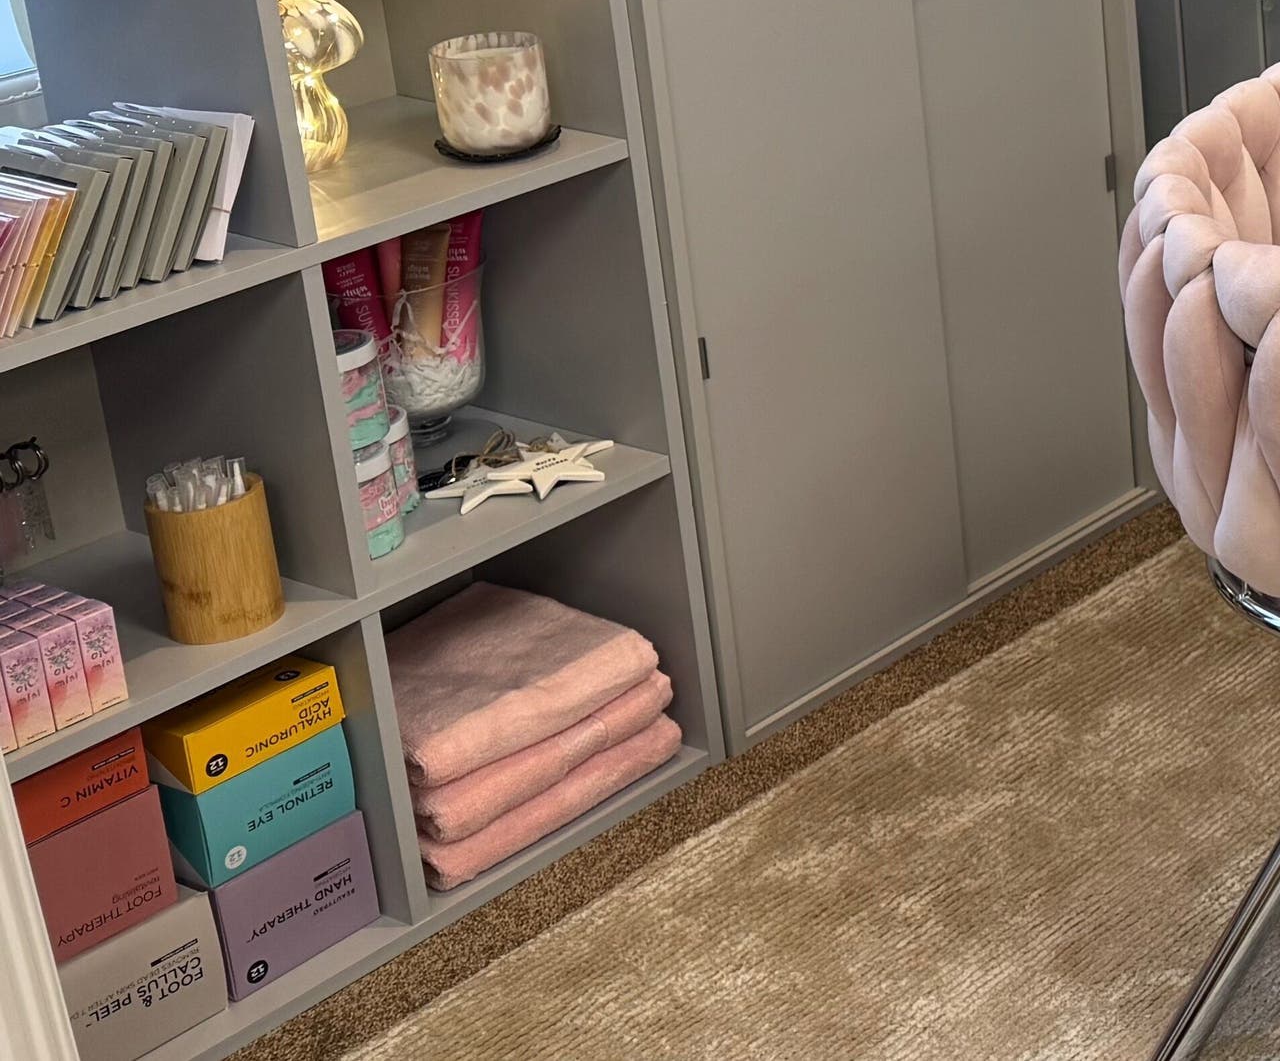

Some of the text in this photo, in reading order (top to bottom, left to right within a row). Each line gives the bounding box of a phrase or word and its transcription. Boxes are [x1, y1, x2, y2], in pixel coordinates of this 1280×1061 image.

[298, 697, 330, 720] ACID
[244, 707, 332, 758] HYALURONIC
[209, 757, 225, 771] 12
[76, 764, 138, 802] VITAMIN
[60, 796, 71, 808] C
[247, 778, 333, 832] RETINOL EYE
[57, 884, 162, 946] FOOT THERAPY
[250, 873, 352, 941] HAND THERAPY
[313, 887, 355, 916] BEAUTYPRO
[136, 968, 161, 984] DEAD
[137, 956, 201, 998] CALLUS
[250, 963, 265, 977] 12
[116, 978, 136, 995] SKIN
[142, 967, 204, 1008] FOOT &
[87, 992, 115, 1012] AFTER
